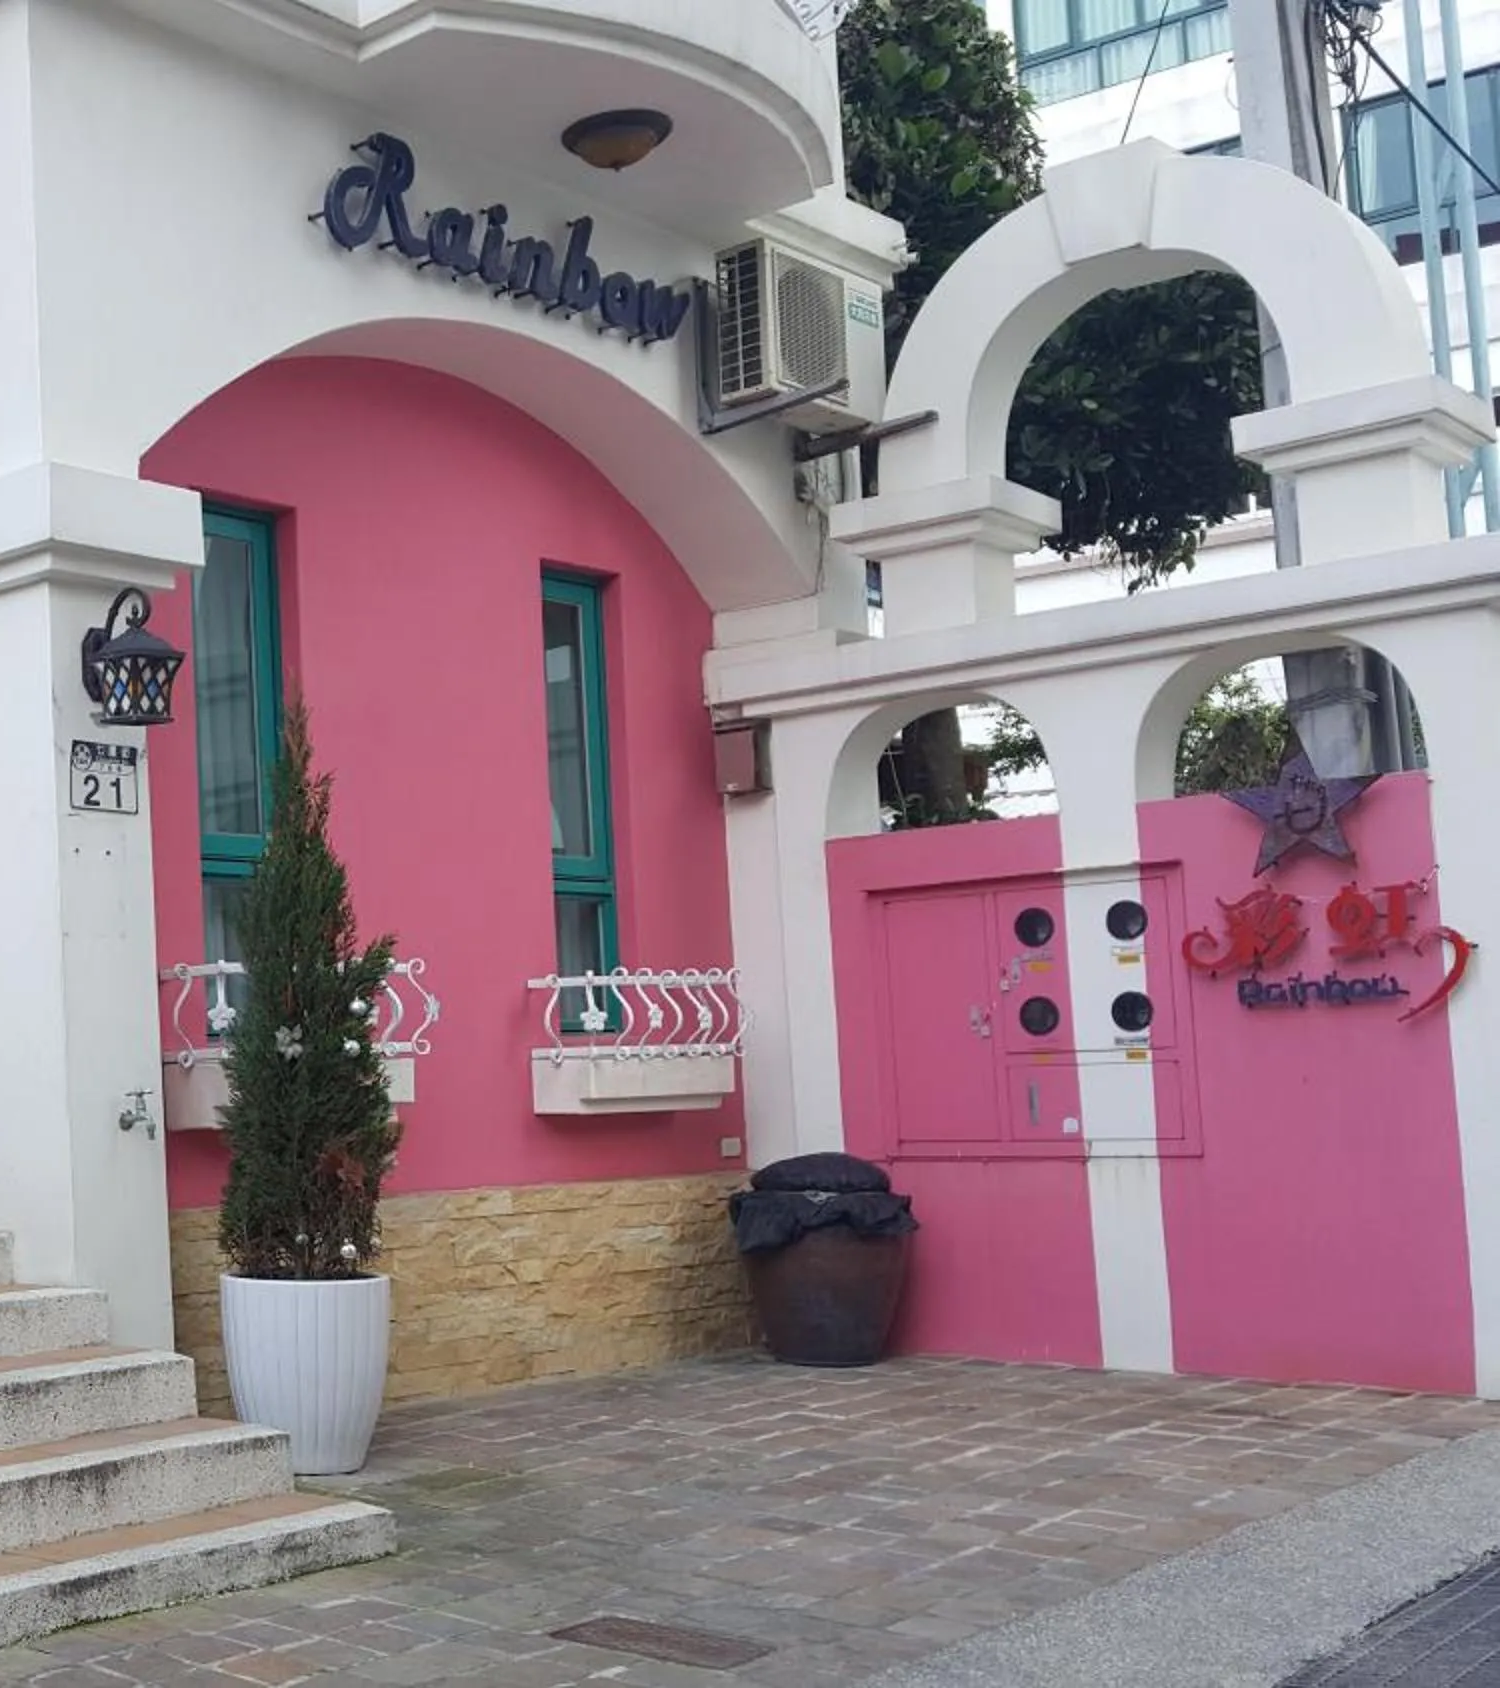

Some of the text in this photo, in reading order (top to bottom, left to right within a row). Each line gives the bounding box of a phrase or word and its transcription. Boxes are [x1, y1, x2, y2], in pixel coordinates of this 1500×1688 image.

[324, 132, 692, 340] Rainbow
[83, 774, 122, 809] 21
[1181, 882, 1470, 1021] 彩虹
[1238, 974, 1409, 1007] Rainbow
